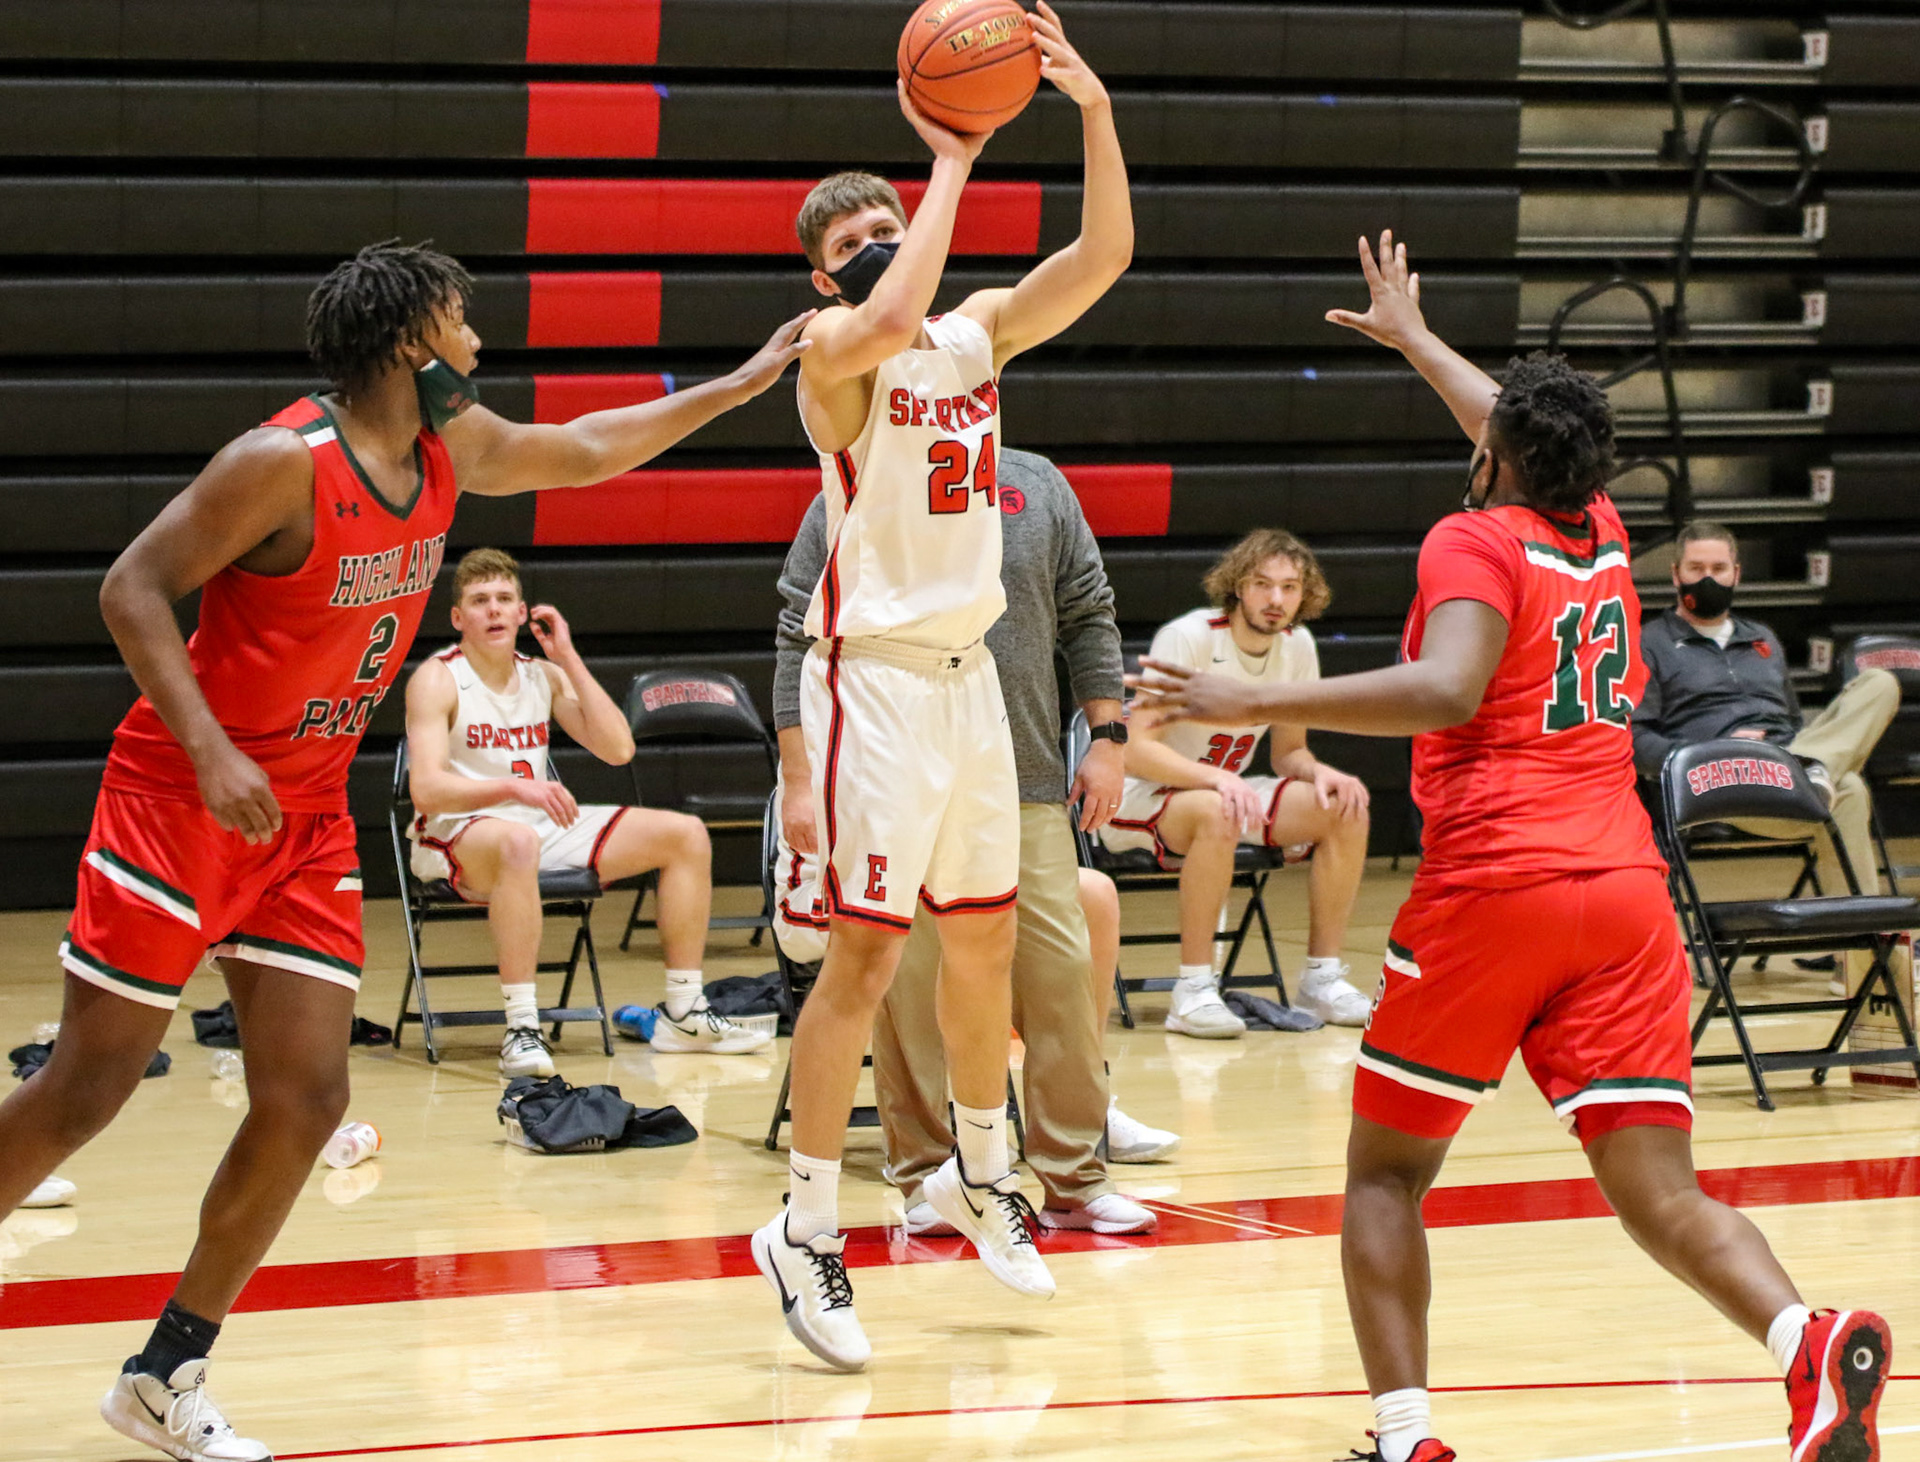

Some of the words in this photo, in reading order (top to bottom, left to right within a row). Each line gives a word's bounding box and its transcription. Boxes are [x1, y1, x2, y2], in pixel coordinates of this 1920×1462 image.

[928, 432, 996, 515] 24
[353, 612, 399, 683] 2
[1542, 595, 1635, 734] 12
[1197, 733, 1256, 773] 32
[1687, 759, 1794, 796] SPARTANS
[864, 854, 887, 902] E
